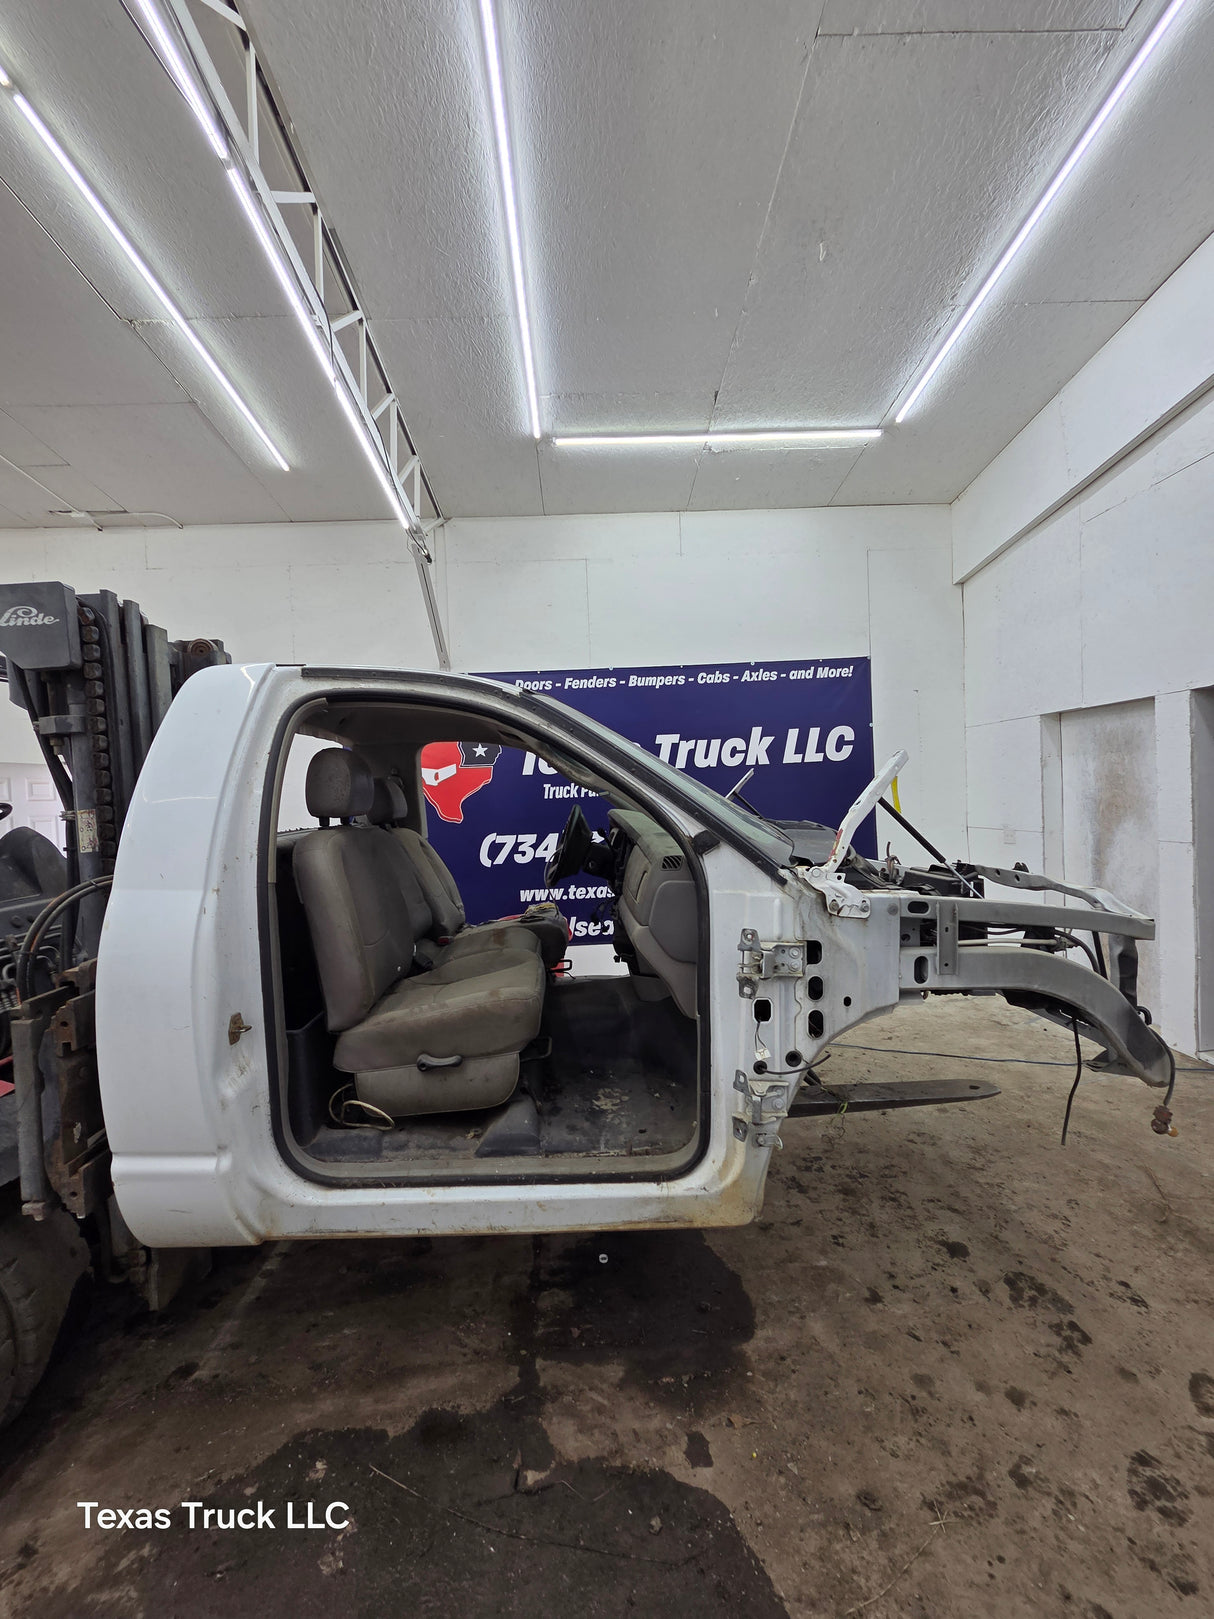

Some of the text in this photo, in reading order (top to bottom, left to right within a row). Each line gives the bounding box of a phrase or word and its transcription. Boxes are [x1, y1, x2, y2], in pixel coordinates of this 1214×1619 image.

[0, 605, 60, 627] Linde
[515, 679, 553, 691] Doors
[564, 675, 617, 689] Fenders
[628, 675, 686, 689] Bumpers
[697, 671, 730, 684] Cabs
[741, 668, 778, 682] Axles
[789, 666, 814, 680] and
[816, 665, 854, 678] More!
[655, 725, 855, 769] Truck LLC
[543, 782, 579, 799] Truck
[480, 832, 560, 868] (734
[520, 885, 616, 902] www.texas
